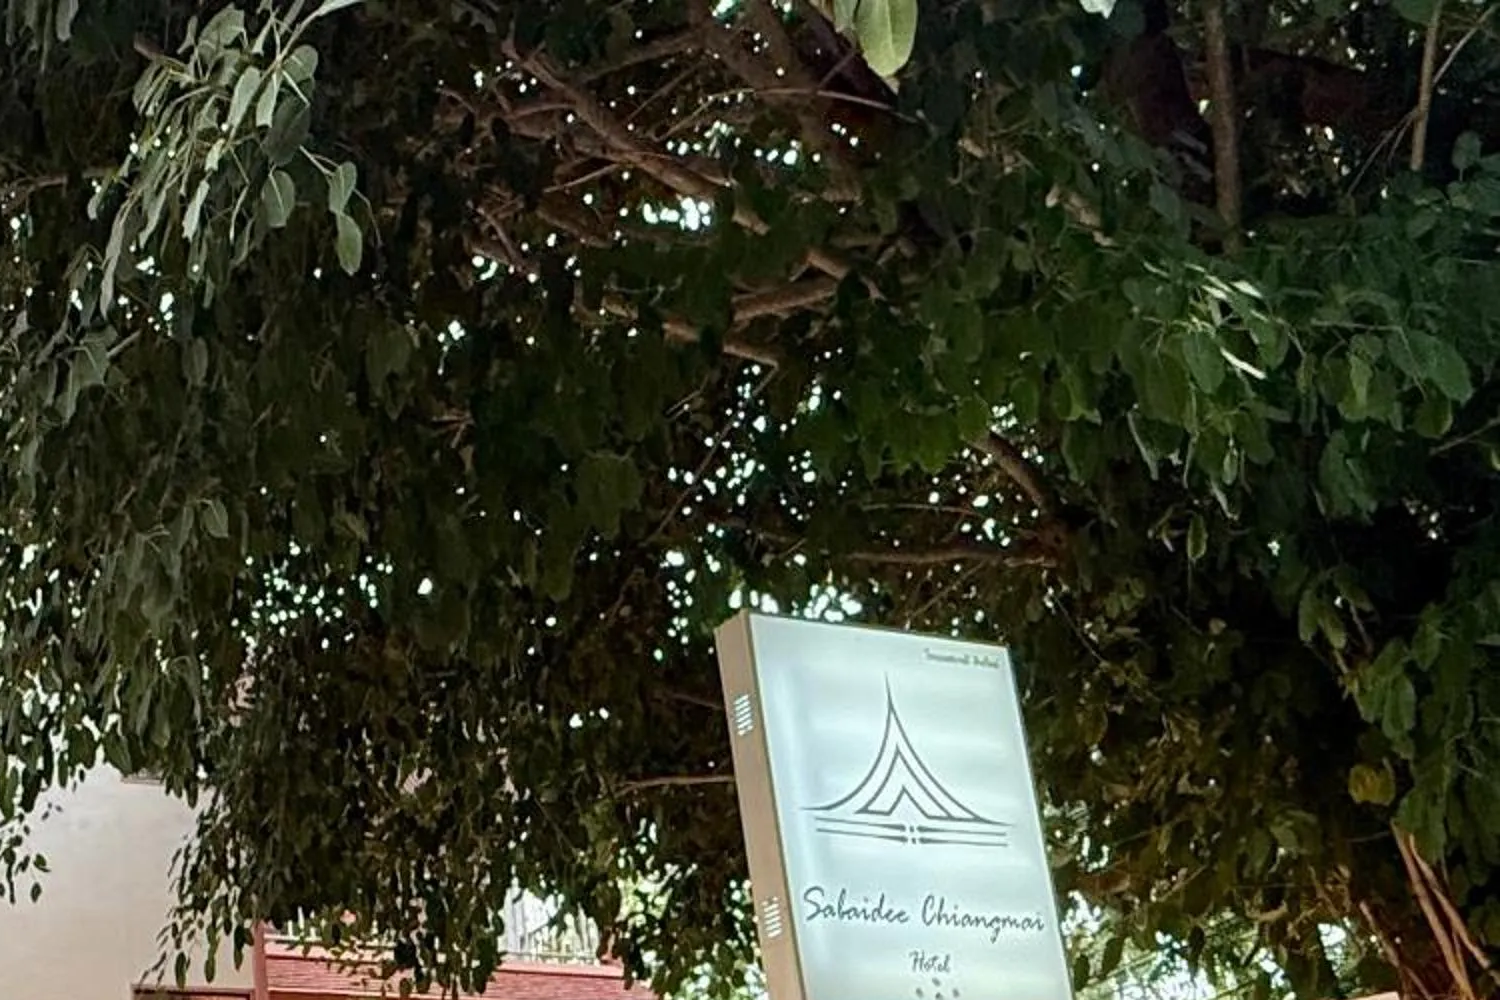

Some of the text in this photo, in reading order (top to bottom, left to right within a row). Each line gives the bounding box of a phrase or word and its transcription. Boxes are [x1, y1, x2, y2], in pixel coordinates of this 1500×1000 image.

[803, 886, 1044, 944] Sabaidee Chiangmai
[909, 950, 951, 974] Hotel
